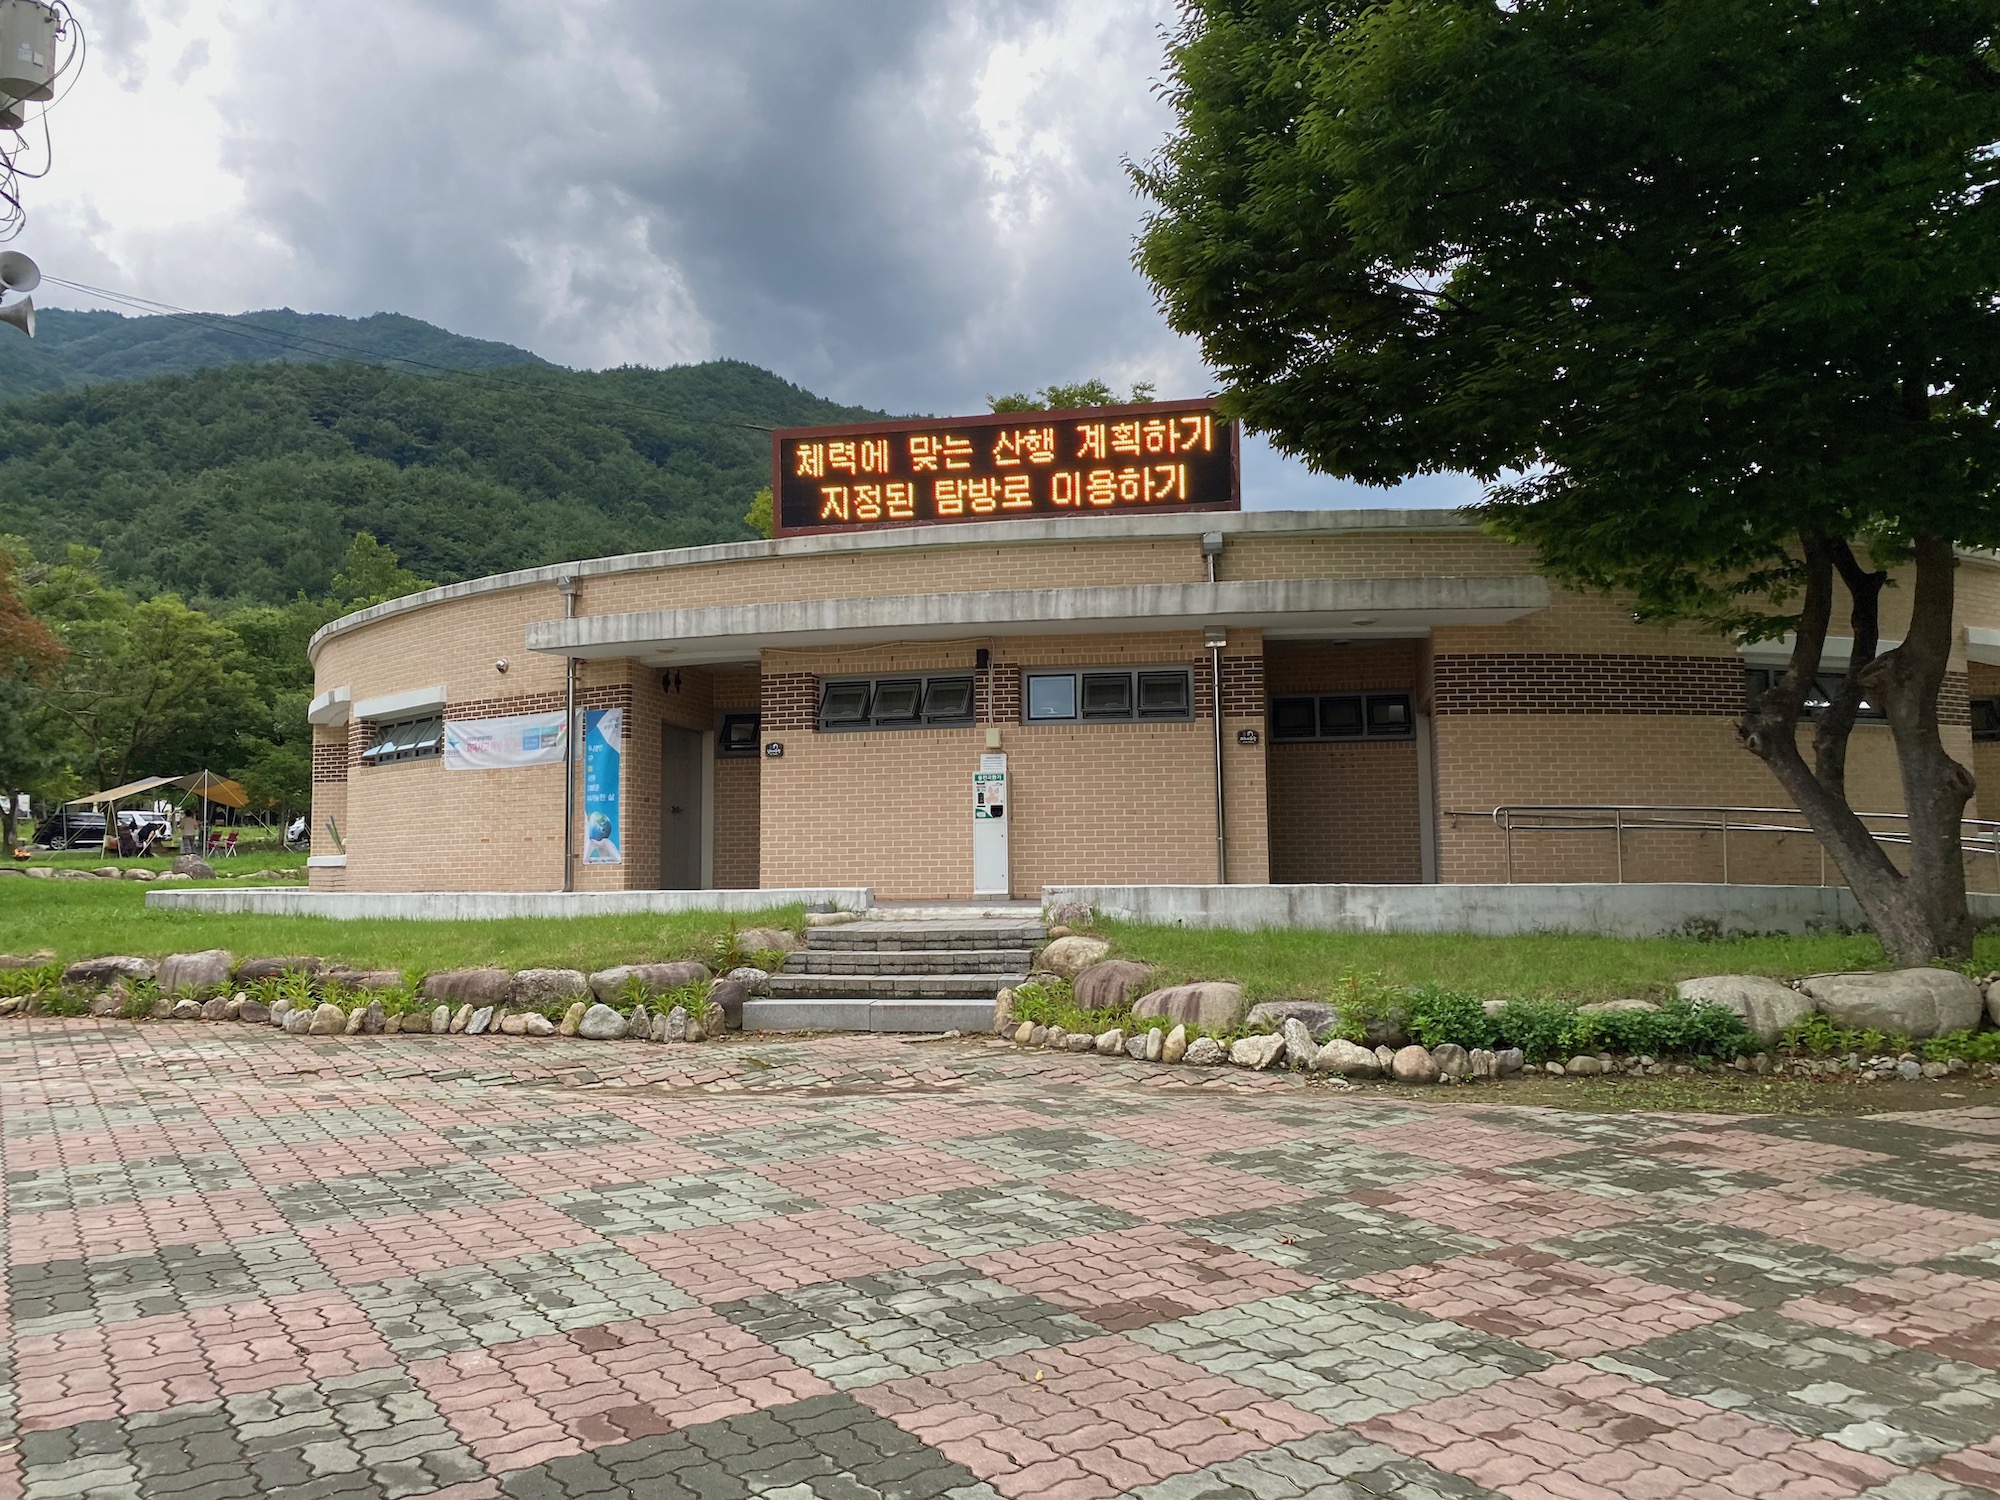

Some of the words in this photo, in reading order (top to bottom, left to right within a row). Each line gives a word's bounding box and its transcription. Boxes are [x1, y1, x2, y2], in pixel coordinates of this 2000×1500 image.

[796, 439, 889, 478] 체력에
[909, 435, 973, 472] 맞는
[992, 427, 1055, 466] 산행
[1076, 415, 1211, 460] 계획하기
[820, 482, 914, 520] 지정된
[934, 475, 1033, 515] 탐방로
[1051, 464, 1186, 507] 이용하기
